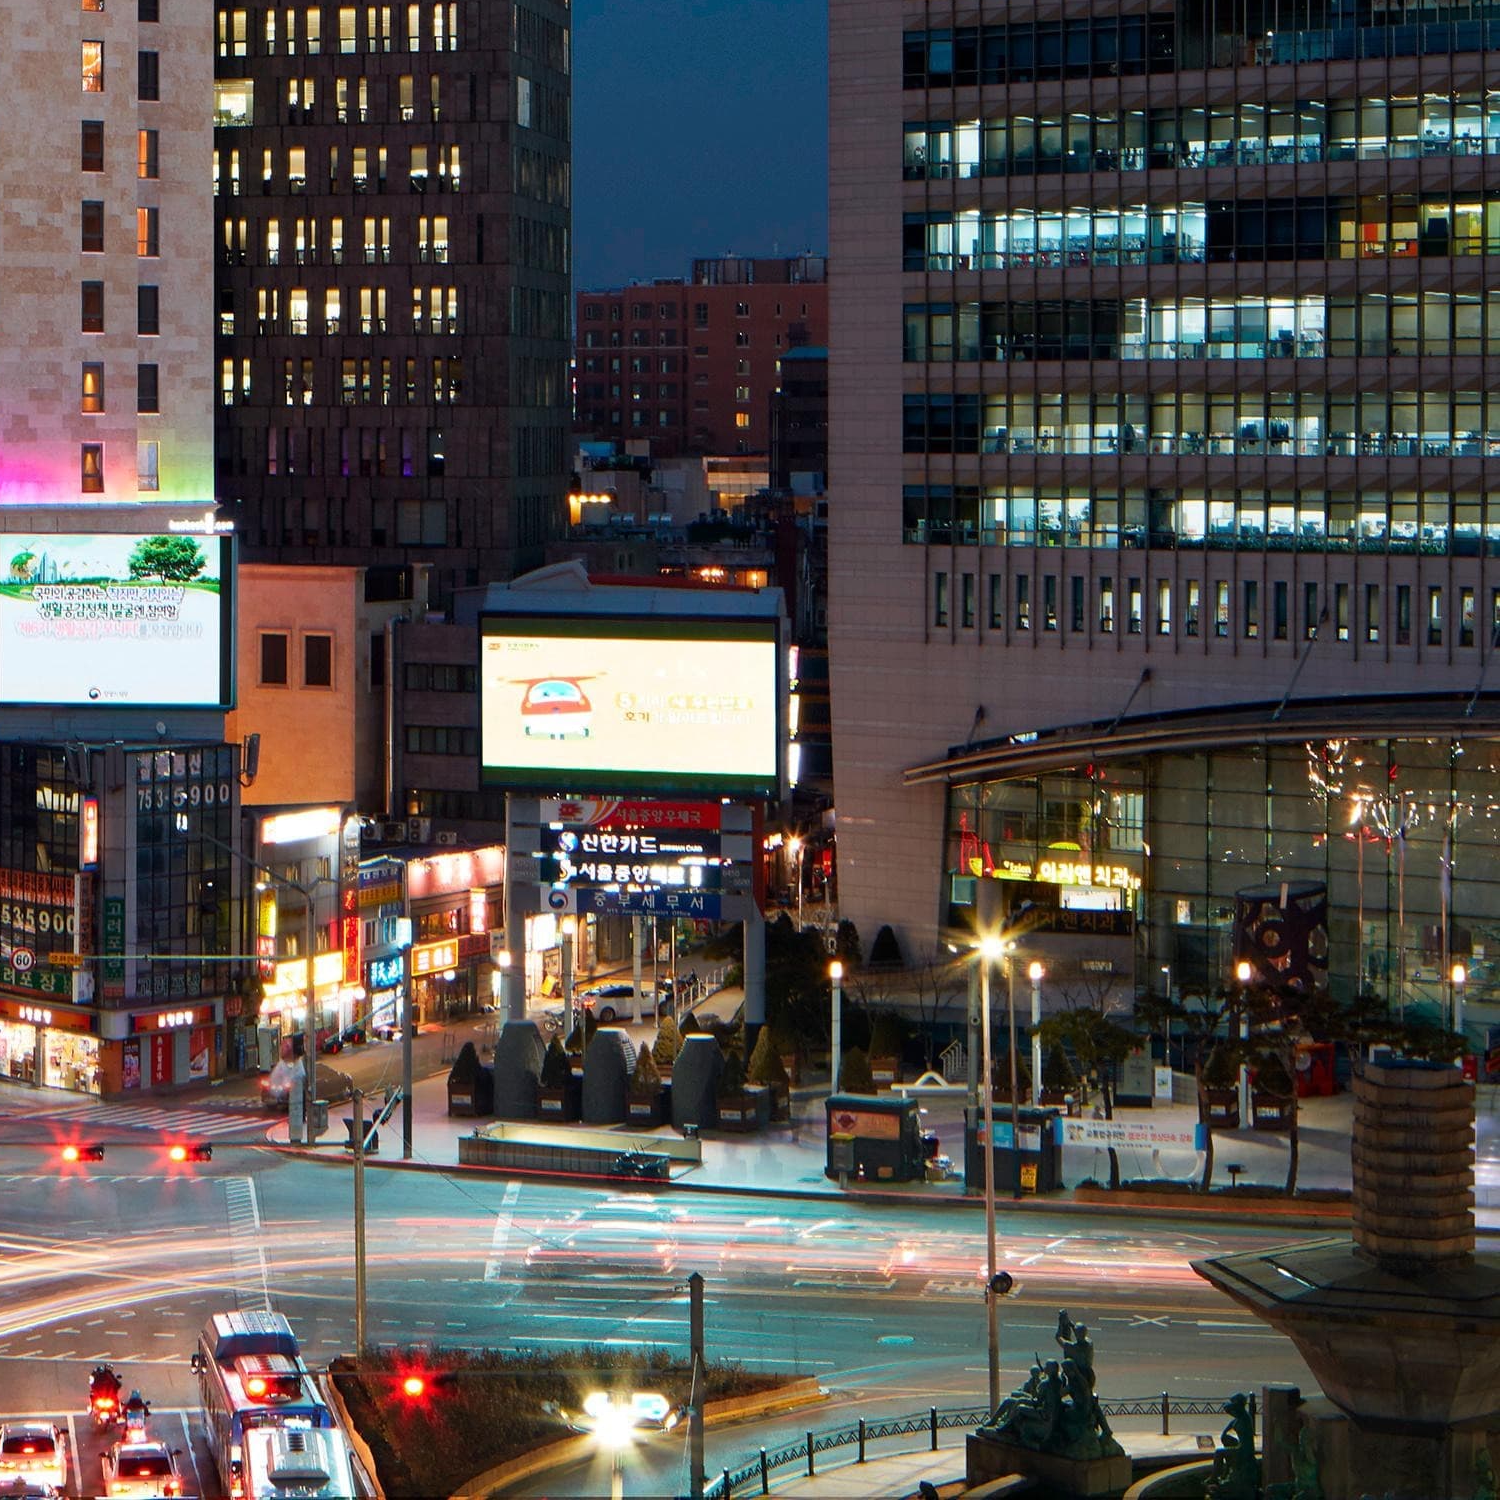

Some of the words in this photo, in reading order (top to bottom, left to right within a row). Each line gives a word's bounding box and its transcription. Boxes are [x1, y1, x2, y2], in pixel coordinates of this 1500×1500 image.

[137, 784, 230, 811] 753-5900
[616, 806, 703, 824] 서울중앙우체국
[581, 833, 657, 853] 신한카드
[1041, 861, 1092, 886] 이지앤
[1095, 865, 1129, 889] 치과
[16, 955, 30, 966] 60
